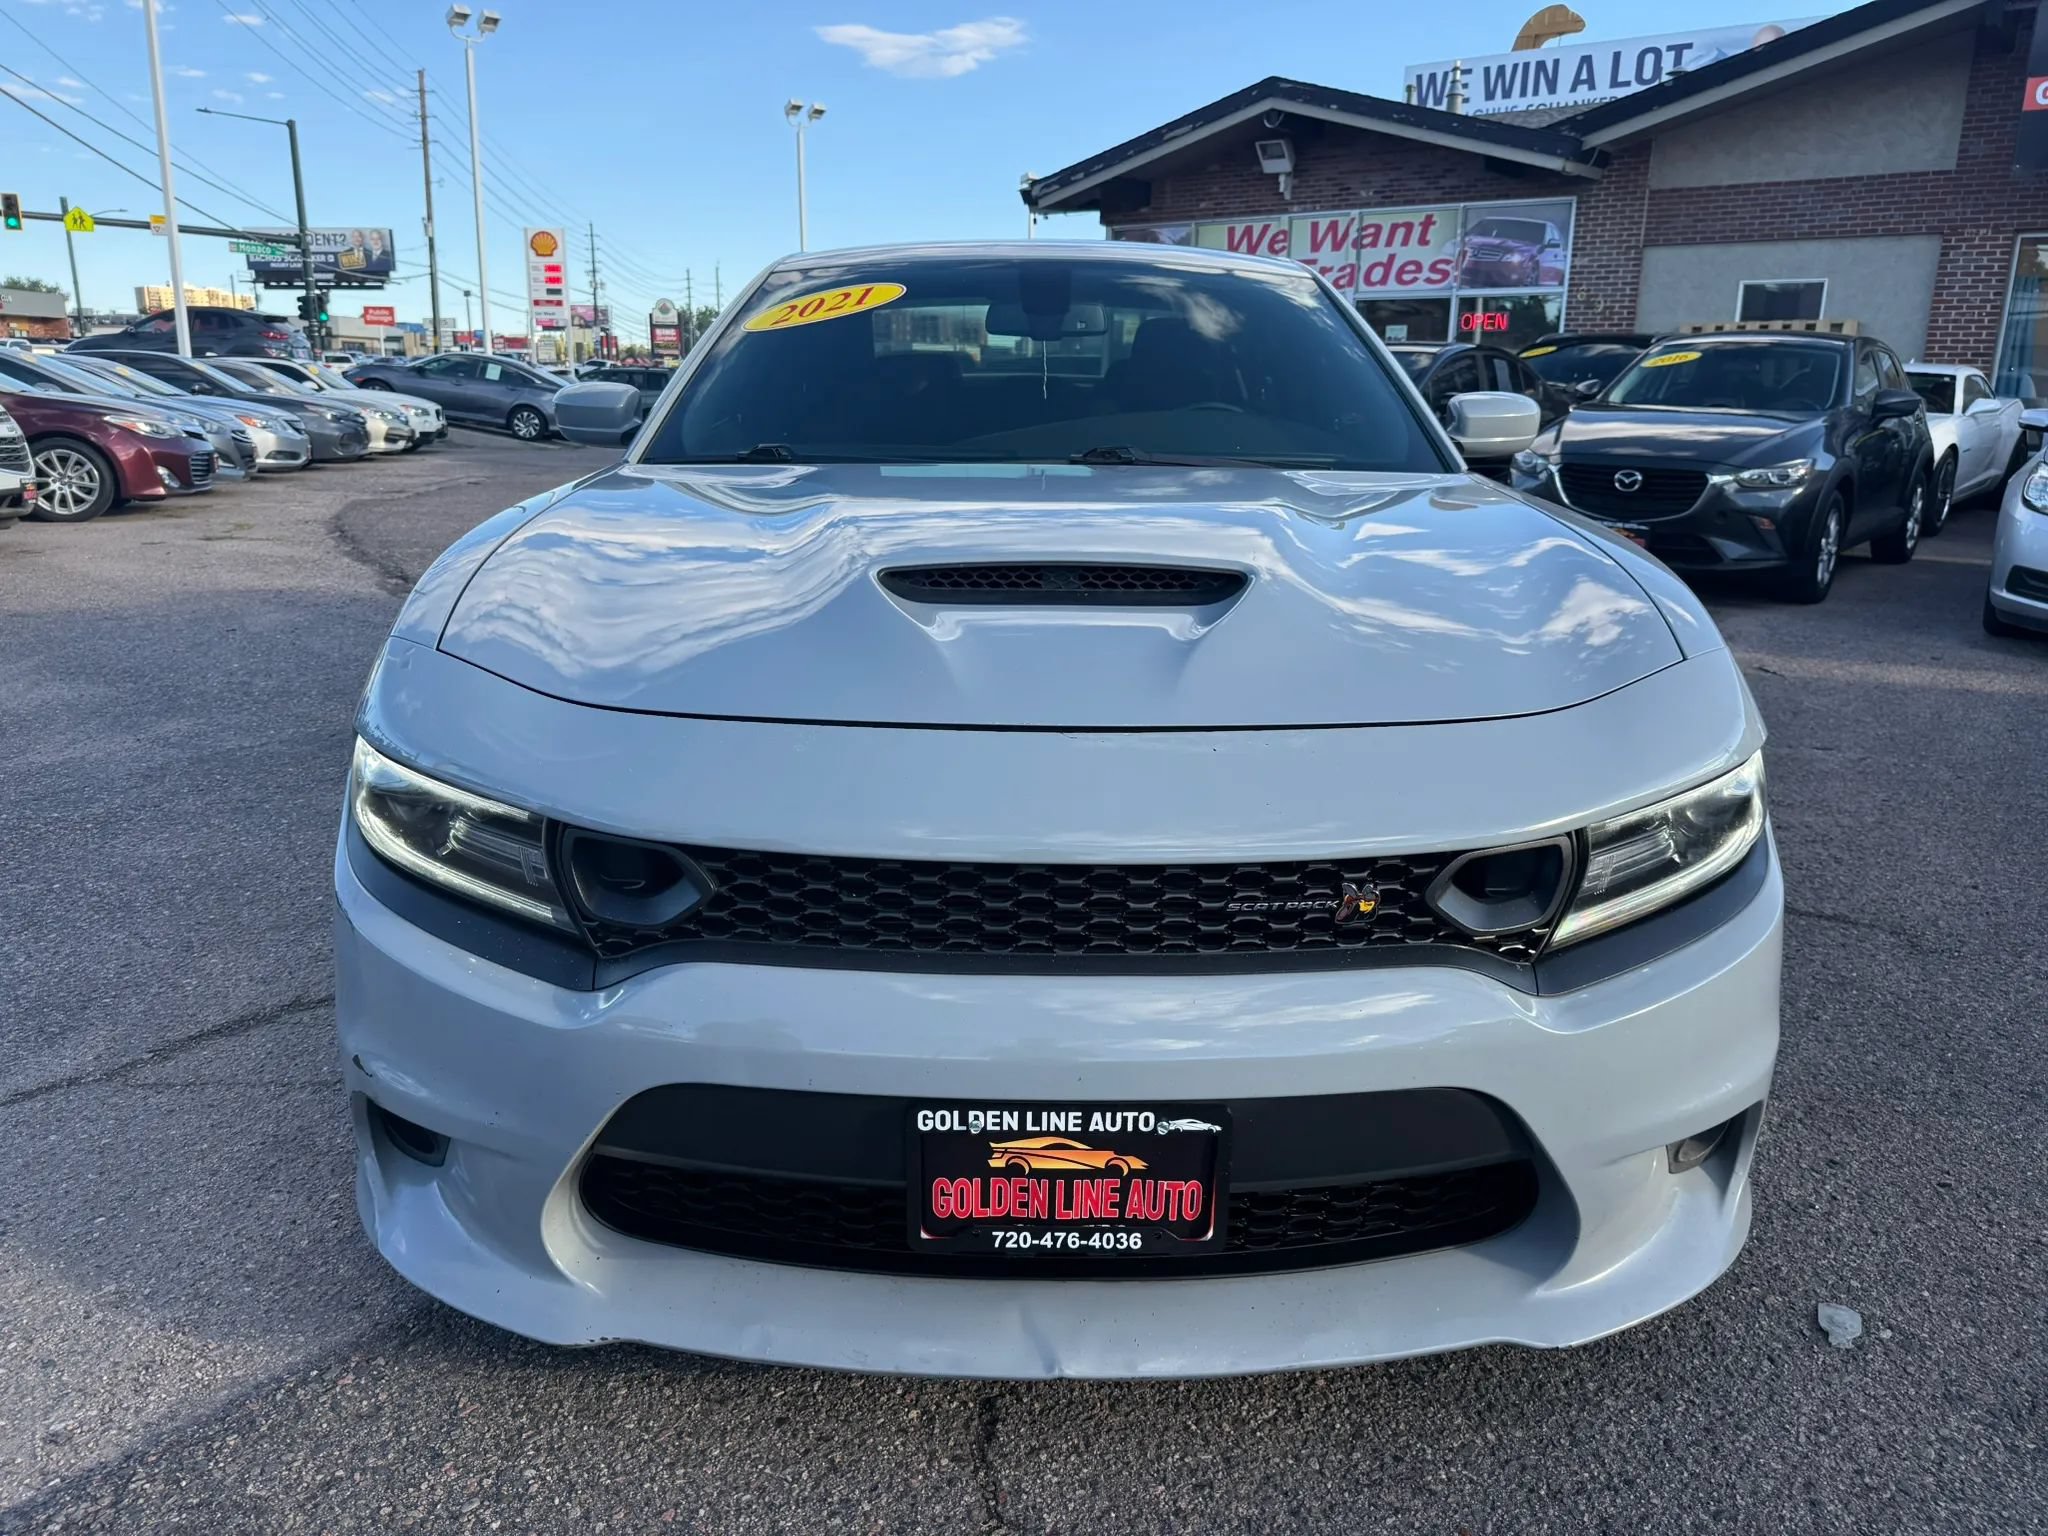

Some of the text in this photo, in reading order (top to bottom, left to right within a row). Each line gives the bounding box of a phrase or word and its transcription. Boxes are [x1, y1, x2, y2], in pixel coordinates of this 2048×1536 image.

[1416, 67, 1473, 108] WE
[1483, 58, 1561, 101] WIN
[1568, 54, 1596, 94] A
[1609, 42, 1694, 89] LOT
[1227, 213, 1437, 256] We Want
[239, 243, 272, 255] Monaco
[770, 286, 875, 326] 2021
[1461, 313, 1507, 330] OPEN
[1227, 900, 1340, 912] SCAT PACK
[917, 1110, 1155, 1132] GOLDEN LINE AUTO
[932, 1177, 1203, 1220] GOLDEN LINE AUTO
[992, 1231, 1142, 1249] 720-476-4036
